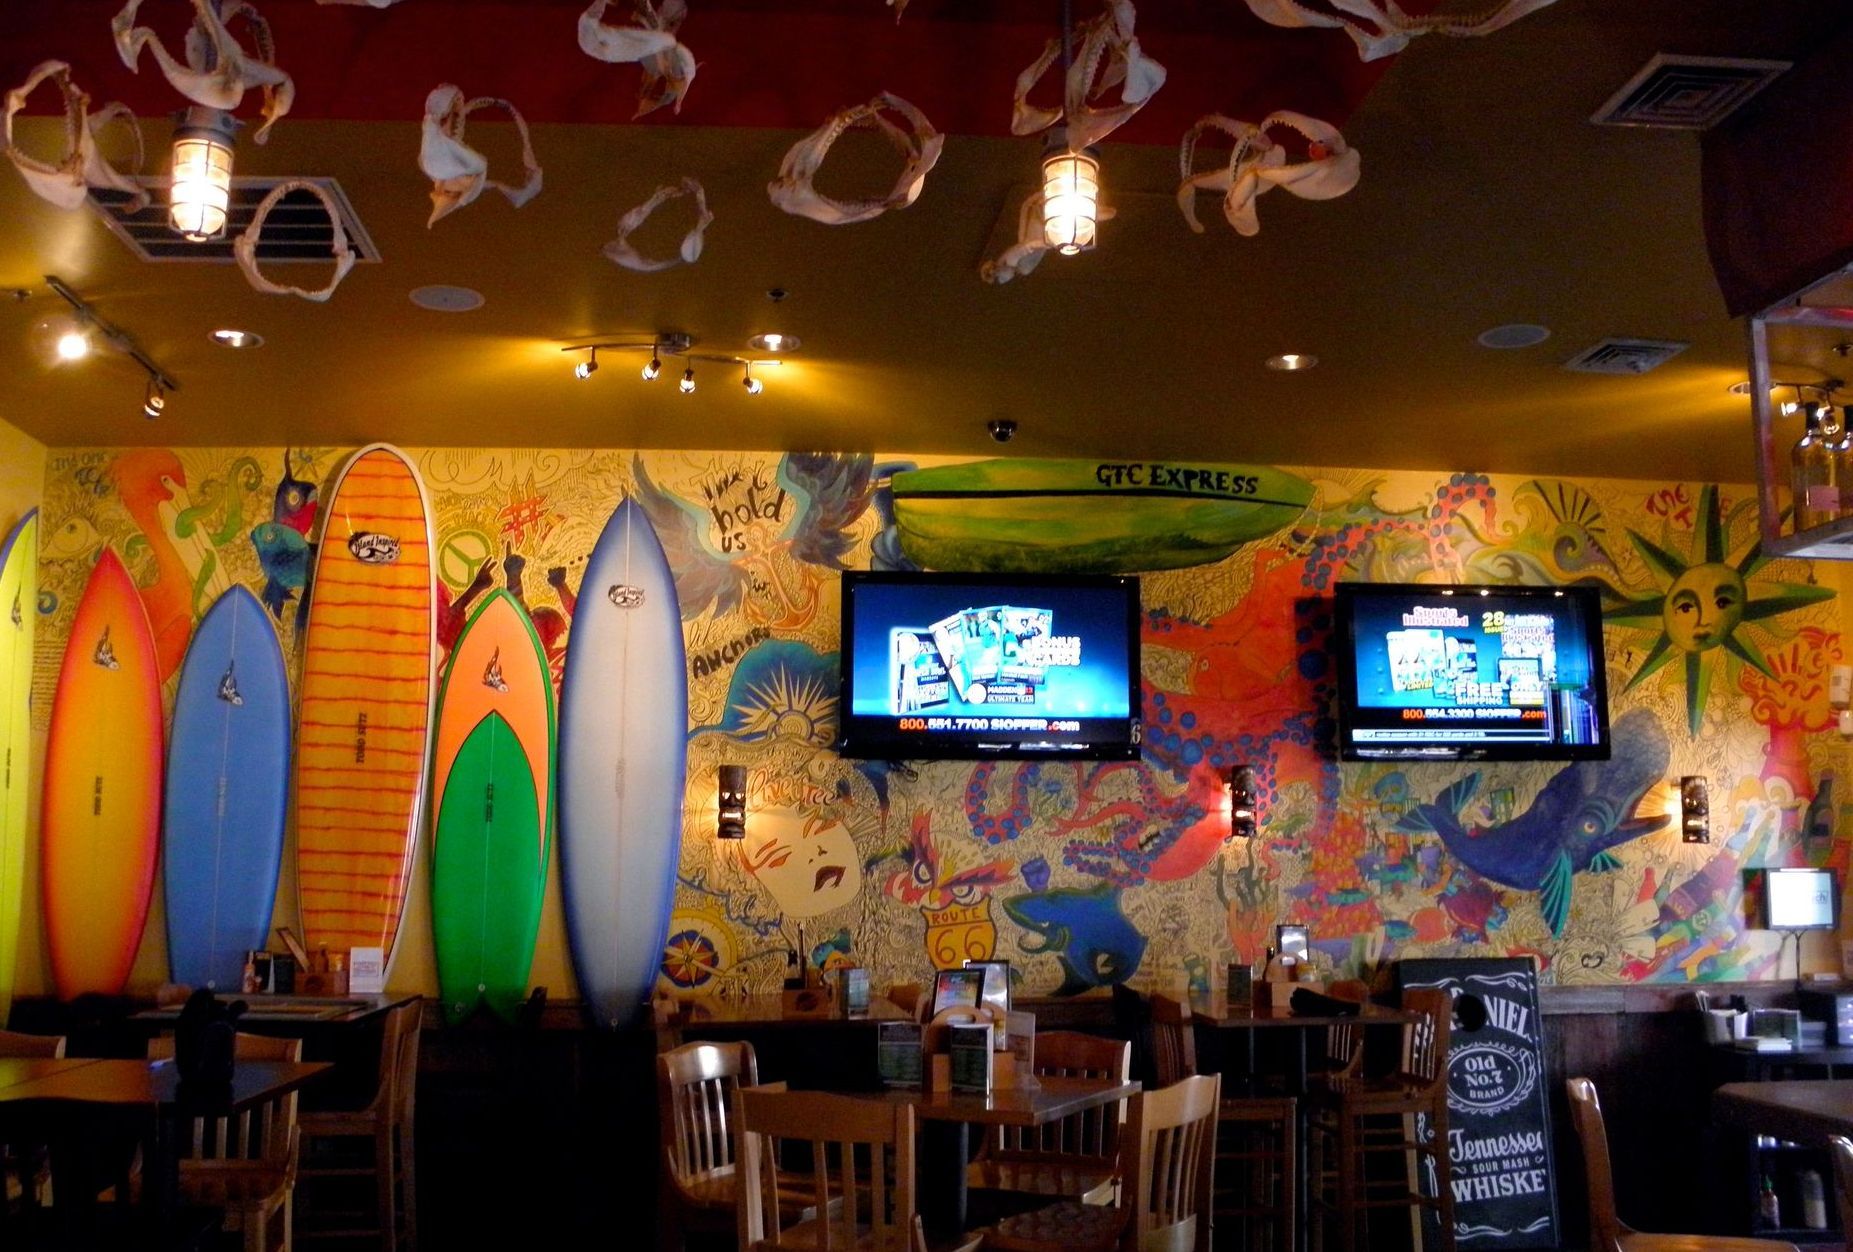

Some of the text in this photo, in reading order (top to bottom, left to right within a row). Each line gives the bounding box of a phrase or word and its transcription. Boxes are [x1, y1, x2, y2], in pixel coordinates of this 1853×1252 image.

[1096, 464, 1259, 494] GTC EXPRESS
[711, 488, 786, 535] hold
[721, 532, 747, 554] us
[1482, 611, 1505, 627] 28
[1455, 682, 1503, 697] FREE
[932, 907, 980, 924] ROUTE
[934, 924, 986, 964] 66
[1450, 986, 1533, 1043] NIEL
[1465, 1055, 1496, 1072] Old
[1470, 1086, 1504, 1099] BRAND
[1473, 1157, 1530, 1174] SOUR MASH
[1450, 1169, 1546, 1203] WHISKE
